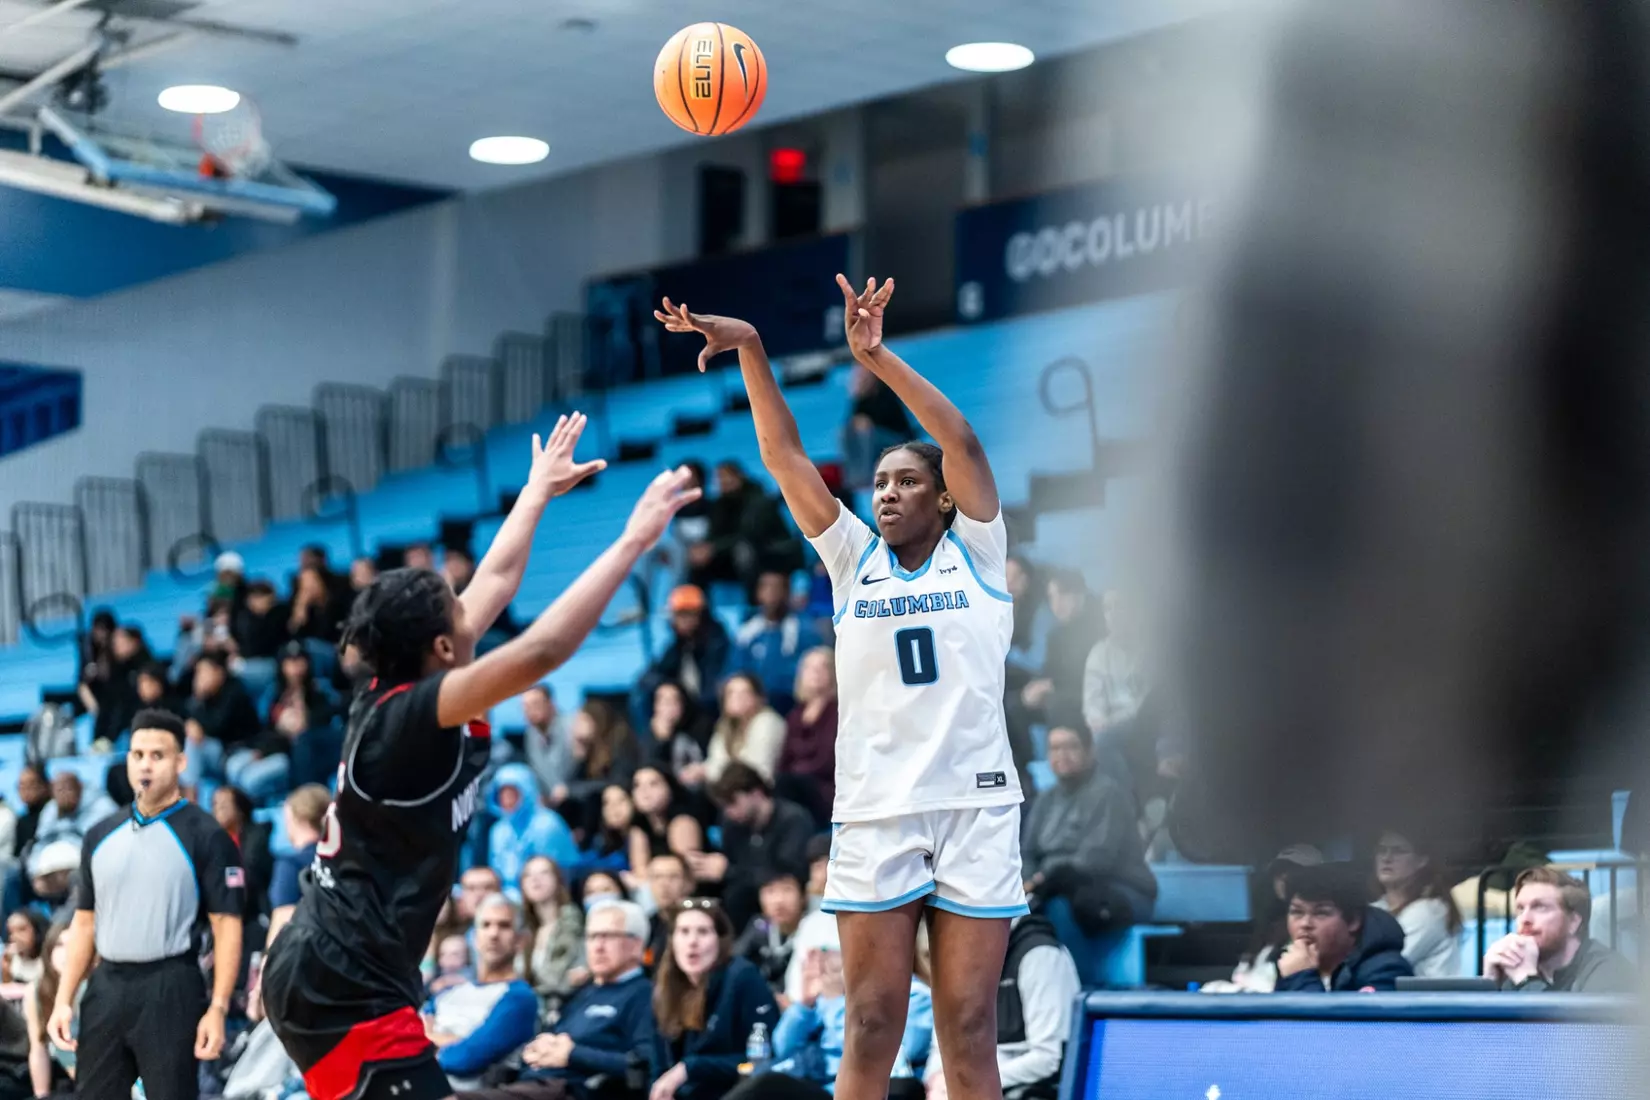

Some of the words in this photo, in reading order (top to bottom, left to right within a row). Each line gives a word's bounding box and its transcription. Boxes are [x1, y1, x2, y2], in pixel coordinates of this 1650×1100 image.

[695, 40, 712, 98] ELITE
[854, 590, 970, 618] COLUMBIA
[893, 625, 940, 687] 0
[996, 775, 1004, 783] XL
